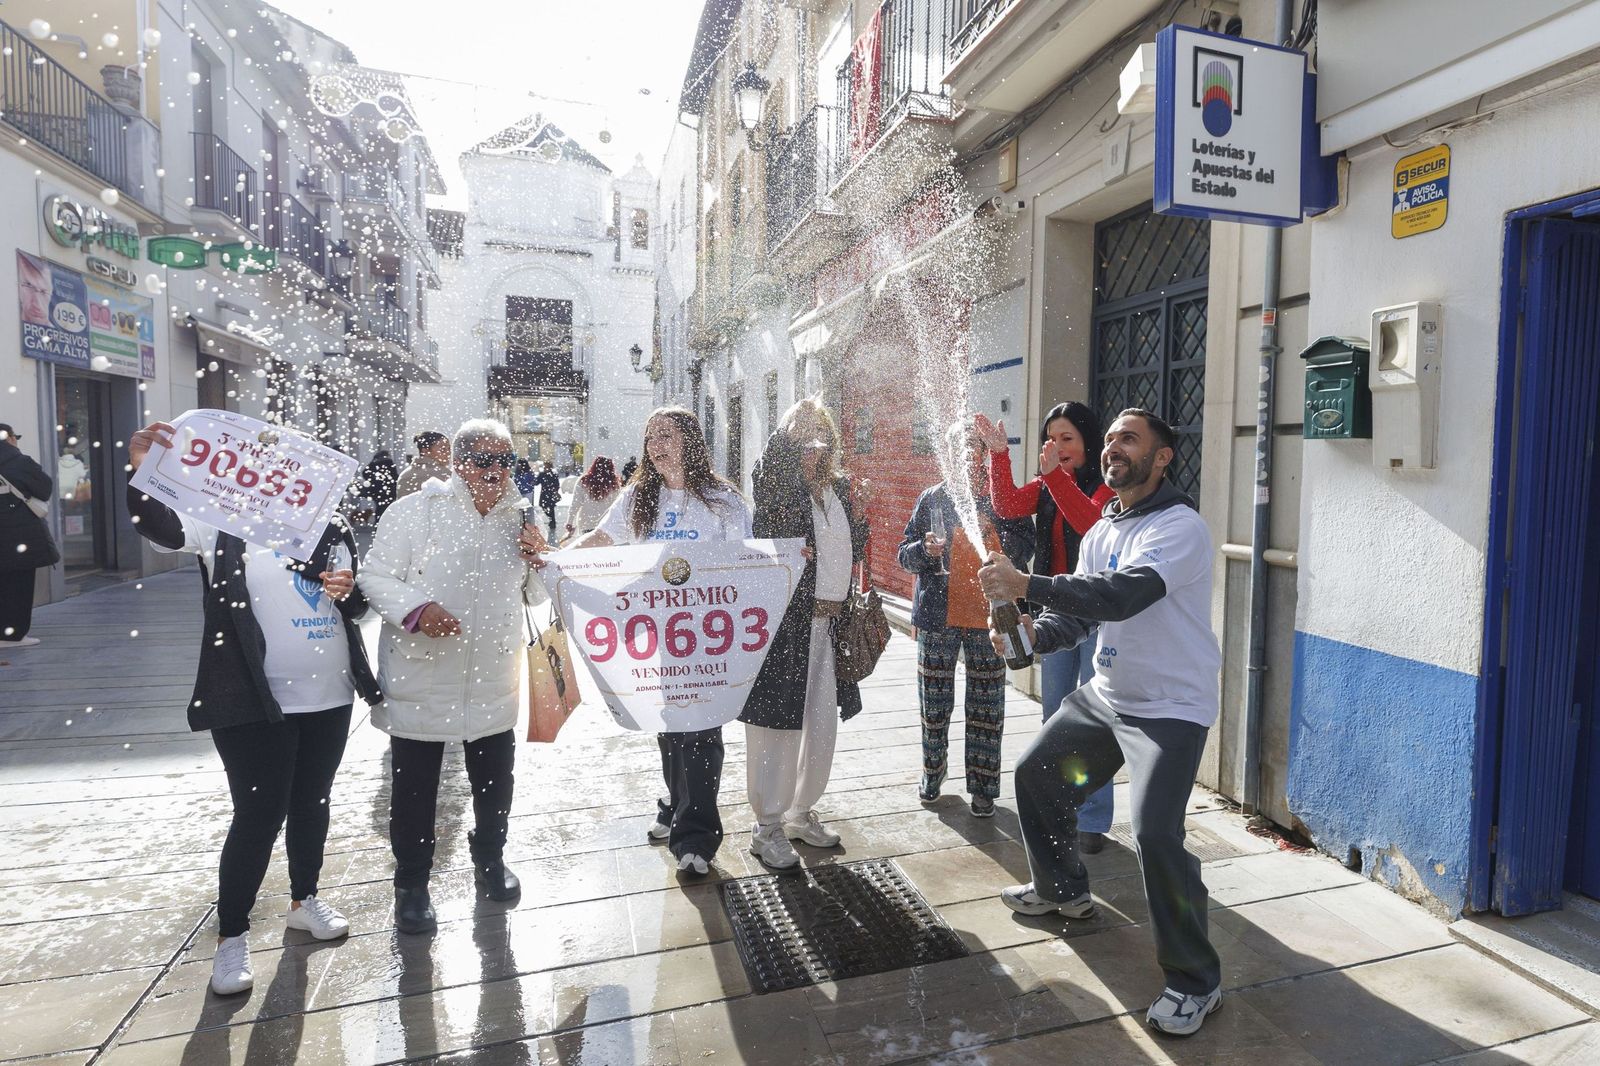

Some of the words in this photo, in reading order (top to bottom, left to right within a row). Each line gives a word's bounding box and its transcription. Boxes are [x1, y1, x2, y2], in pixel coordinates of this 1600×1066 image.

[1192, 138, 1245, 160] Loterías
[1247, 150, 1256, 166] y
[1192, 158, 1252, 181] Apuestas
[1255, 167, 1274, 184] del
[1409, 158, 1446, 178] SECUR
[1191, 177, 1237, 197] Estado
[1412, 183, 1436, 197] AVISO
[23, 323, 89, 349] PROGRESIVOS
[24, 336, 62, 355] GAMA
[63, 346, 89, 360] ALTA
[179, 438, 313, 508] 90693
[647, 529, 699, 541] PREMIO
[643, 585, 738, 610] PREMIO
[585, 606, 770, 663] 90693
[631, 665, 691, 679] VENDIDO
[694, 659, 728, 676] AQUÍ
[705, 679, 728, 688] ISABEL
